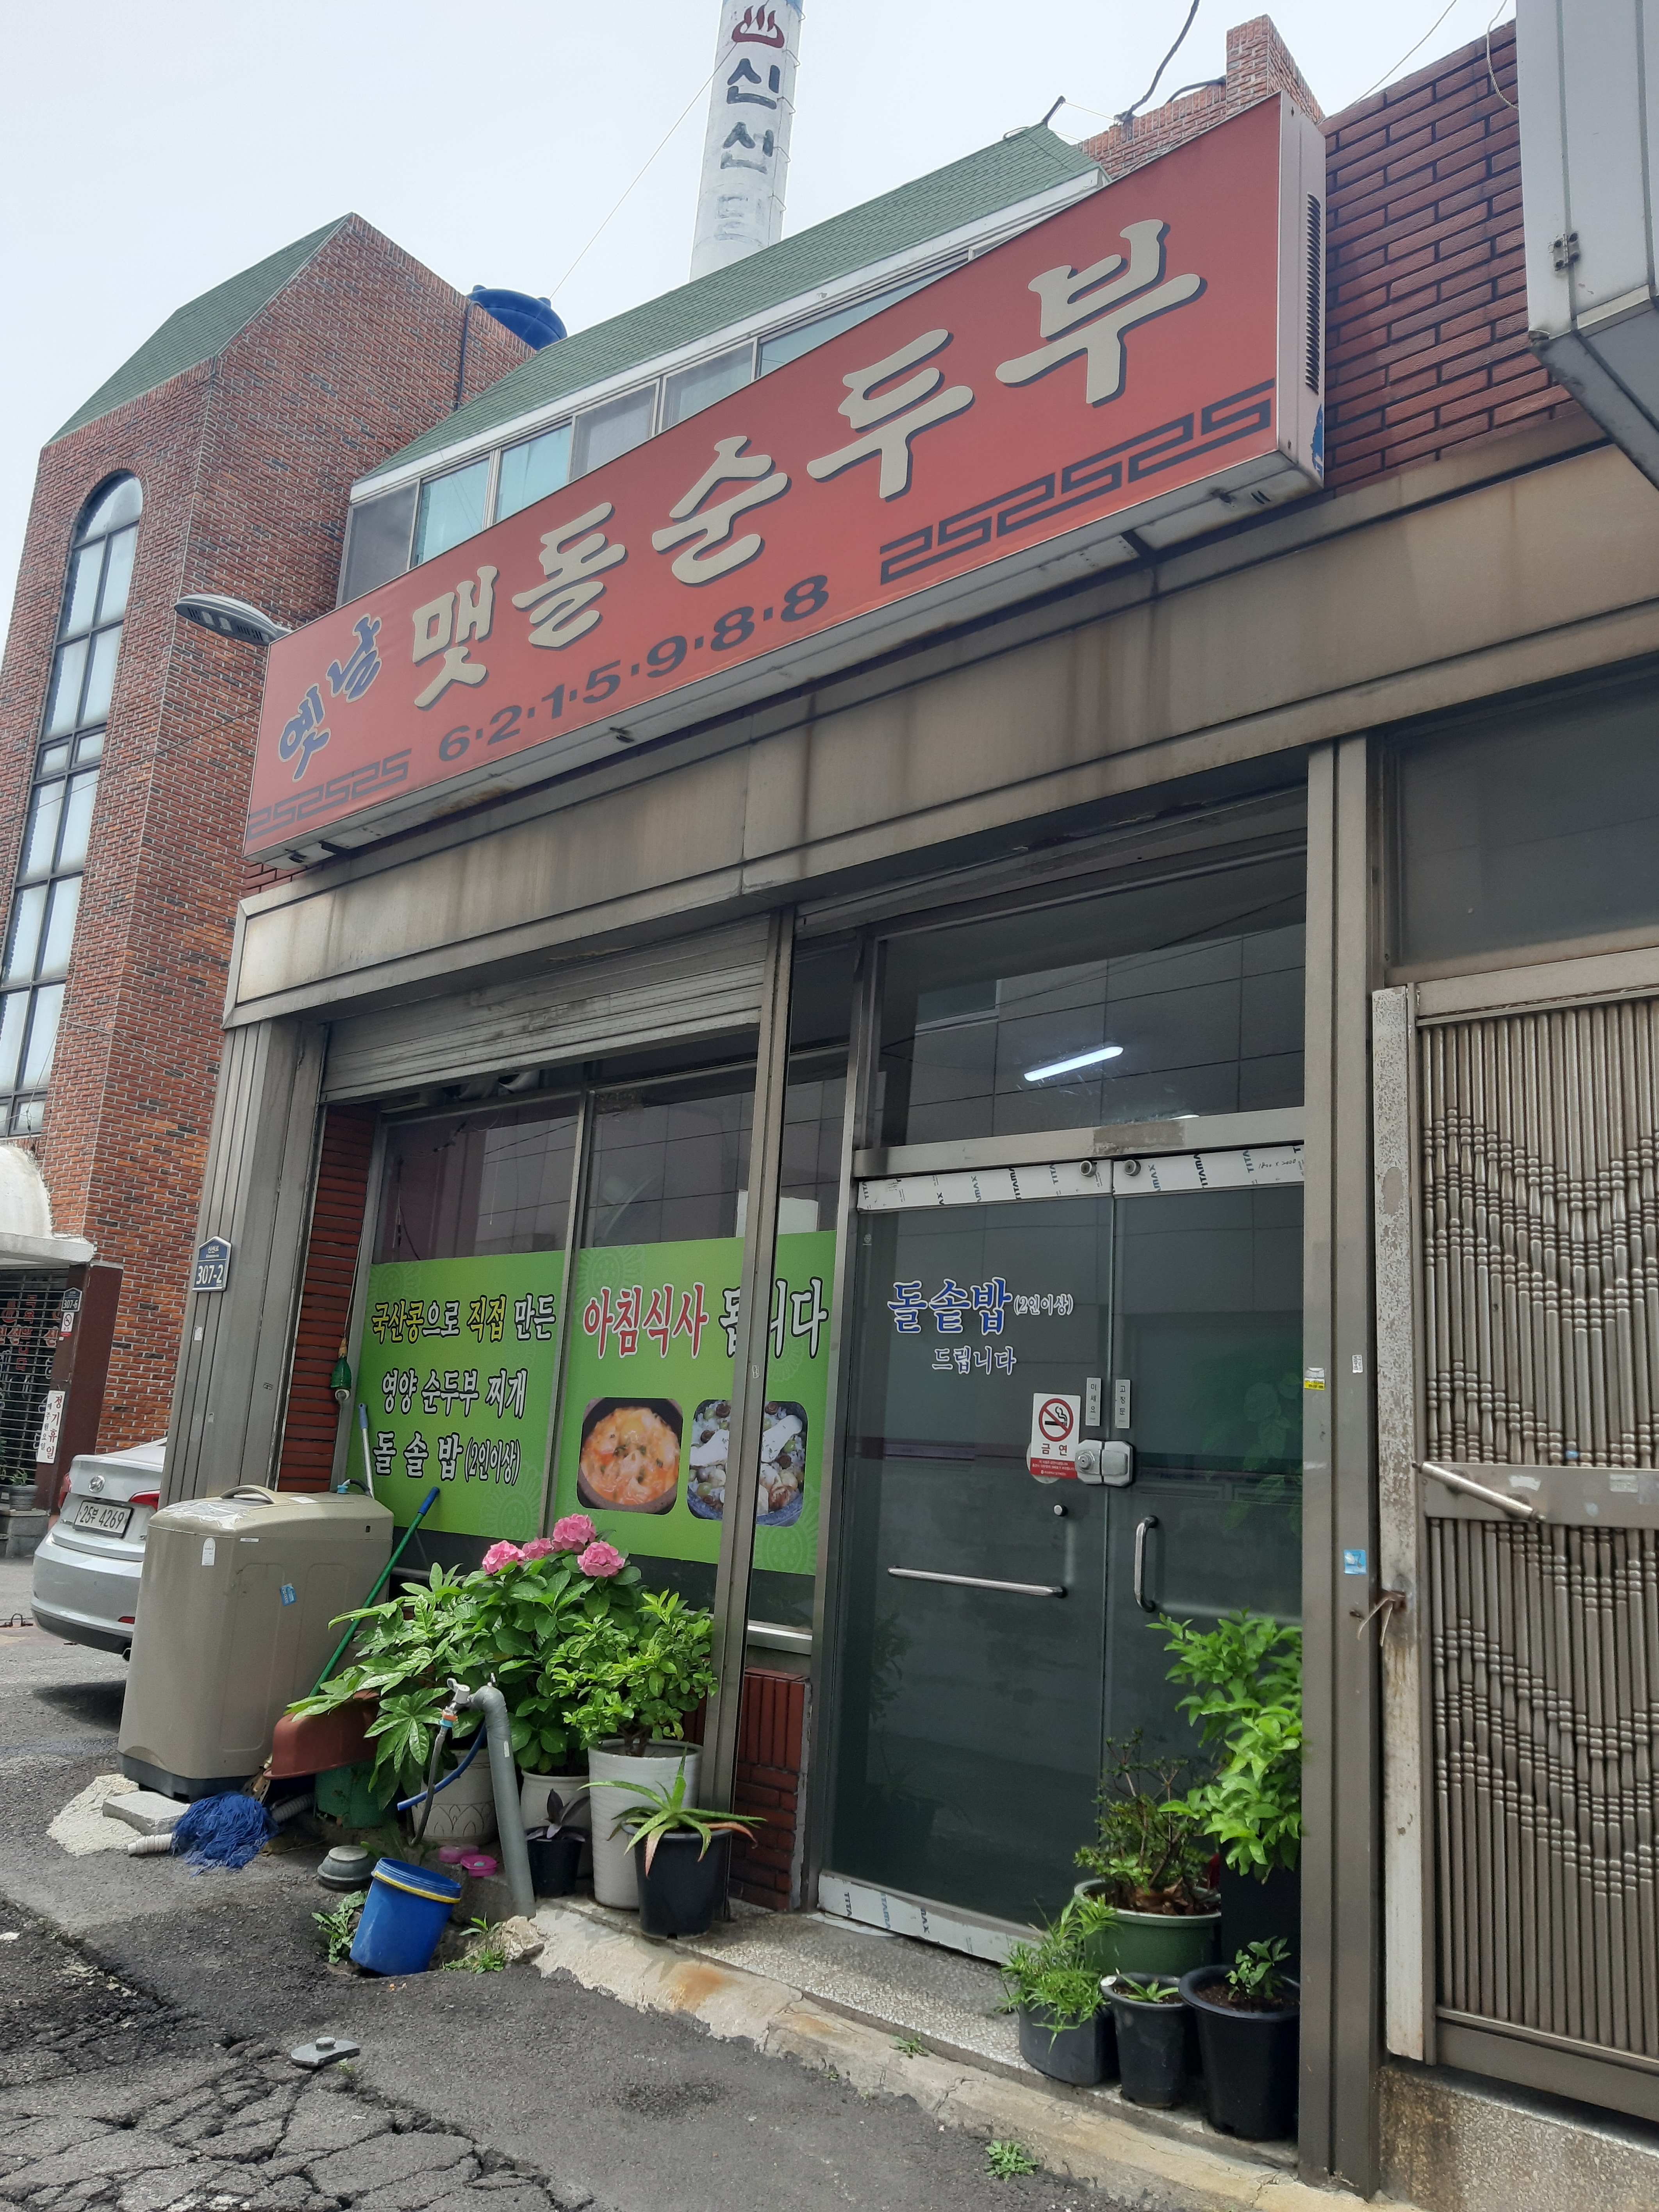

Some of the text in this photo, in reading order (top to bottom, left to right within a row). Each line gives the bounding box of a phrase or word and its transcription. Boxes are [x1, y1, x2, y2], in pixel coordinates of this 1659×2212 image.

[278, 613, 382, 781] 옛날
[196, 1264, 223, 1284] 307-2
[62, 1300, 78, 1309] 307-6
[372, 1293, 556, 1345] 국산콩으로 직접 만든
[582, 1282, 708, 1359] 아침식사
[931, 1345, 1017, 1375] 드립니다
[382, 1368, 528, 1419] 영양 순두부 찌개
[46, 1395, 63, 1459] 정기휴일
[80, 1505, 125, 1529] 25부 4269
